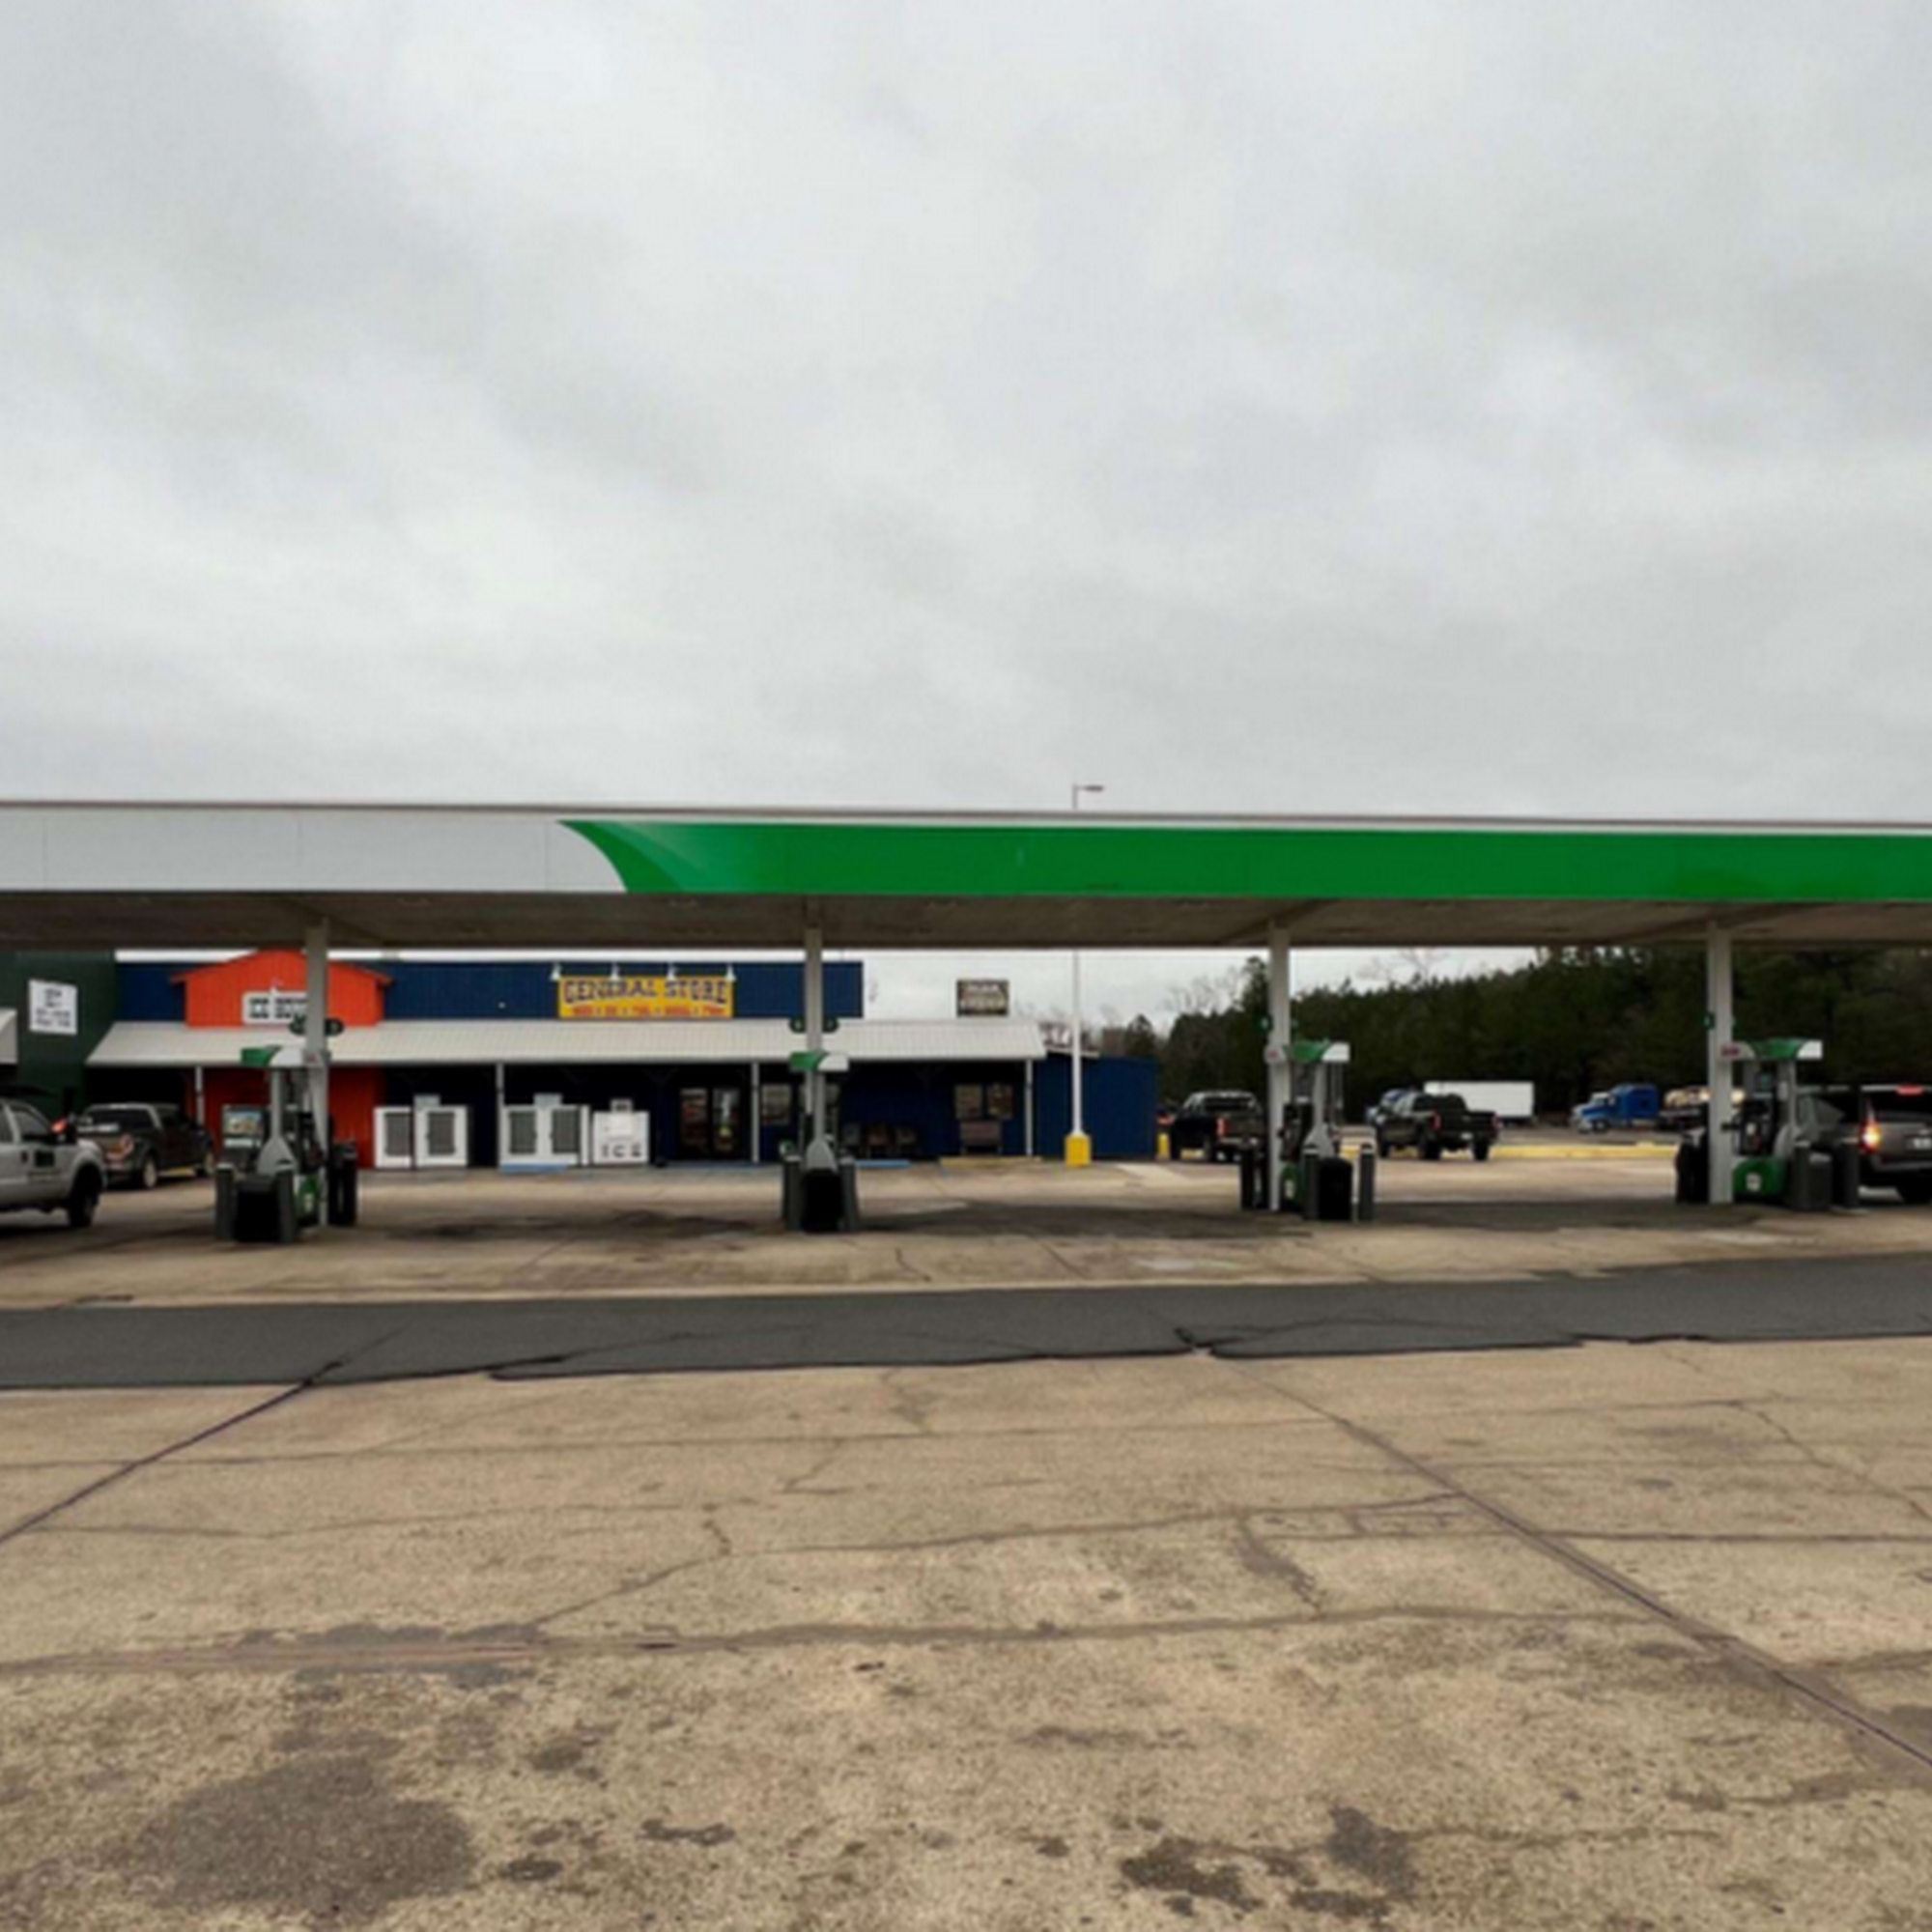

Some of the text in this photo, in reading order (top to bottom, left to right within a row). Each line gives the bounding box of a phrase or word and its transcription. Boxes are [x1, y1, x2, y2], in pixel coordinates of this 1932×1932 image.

[564, 980, 727, 1004] GENERAL STORE
[601, 1143, 642, 1158] ICE
